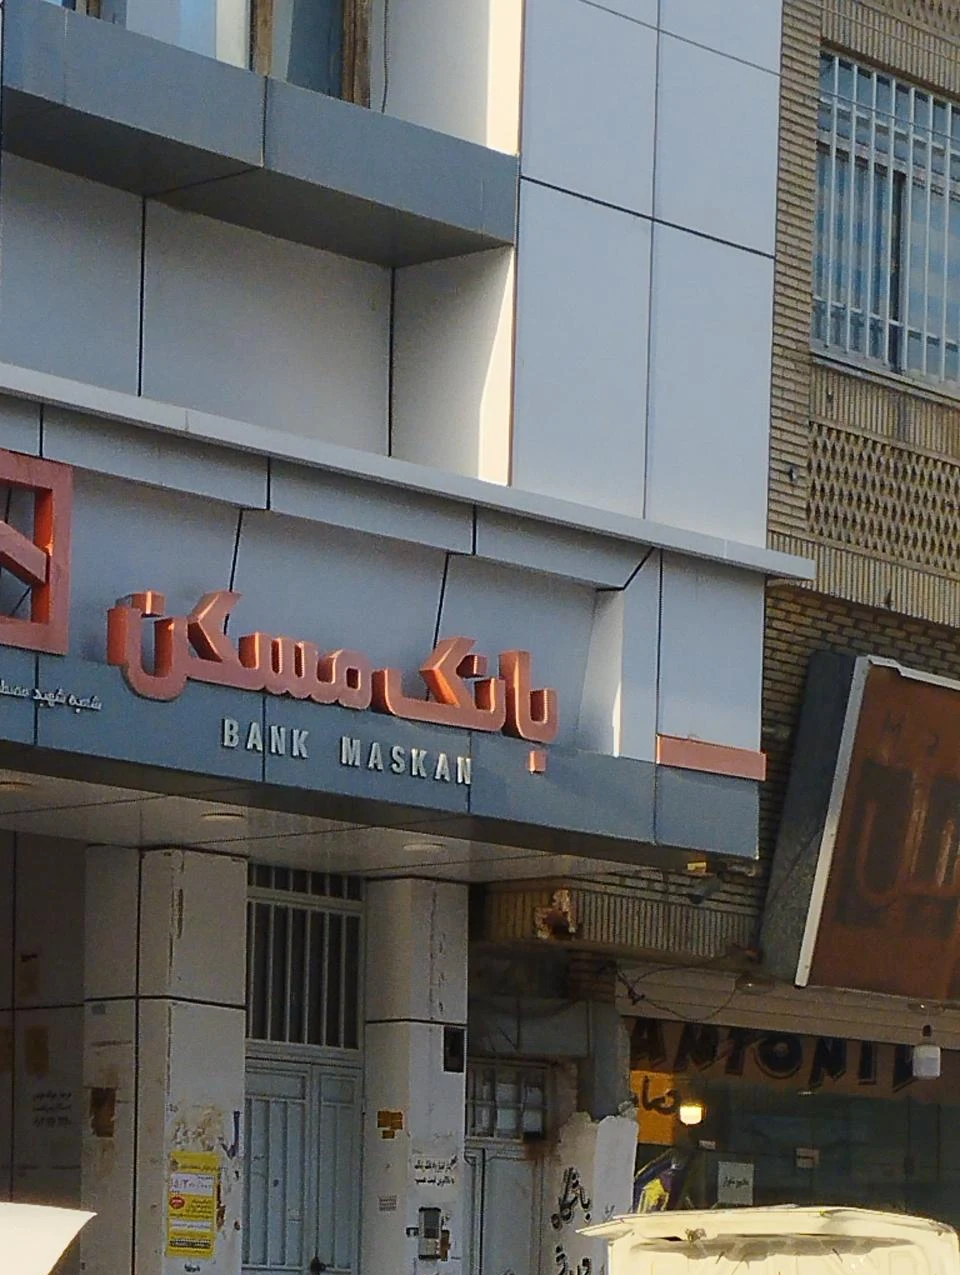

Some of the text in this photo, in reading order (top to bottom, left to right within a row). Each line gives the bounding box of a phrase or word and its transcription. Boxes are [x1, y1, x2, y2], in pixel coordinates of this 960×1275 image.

[32, 687, 67, 708] شهید
[68, 692, 103, 714] شعبه
[107, 590, 559, 776] بانک مسکن
[222, 716, 473, 787] BANK MASKAN
